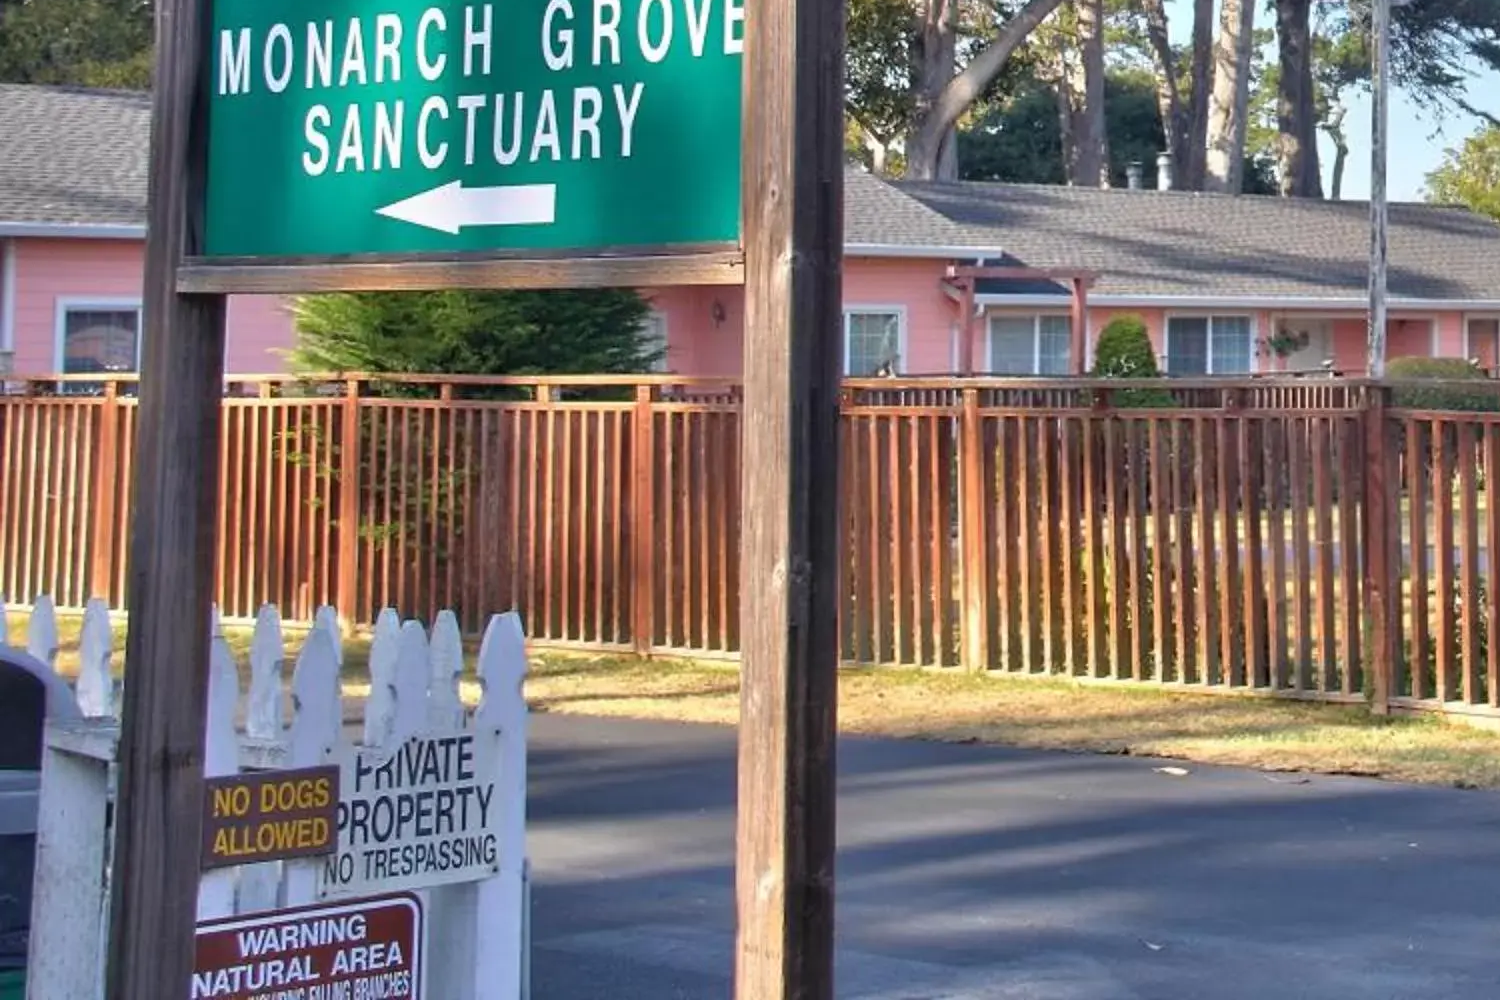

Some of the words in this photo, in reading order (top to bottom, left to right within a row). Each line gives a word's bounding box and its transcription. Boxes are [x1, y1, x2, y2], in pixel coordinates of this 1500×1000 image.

[218, 3, 493, 95] MONARCH
[303, 83, 645, 176] SANCTUARY
[213, 786, 250, 818] NO
[260, 778, 330, 814] DOGS
[213, 817, 329, 856] ALLOWED
[323, 853, 354, 886] NO
[363, 834, 497, 880] TRESPASSING
[238, 914, 367, 958] WARNING
[191, 955, 320, 999] NATURAL
[331, 941, 404, 976] AREA
